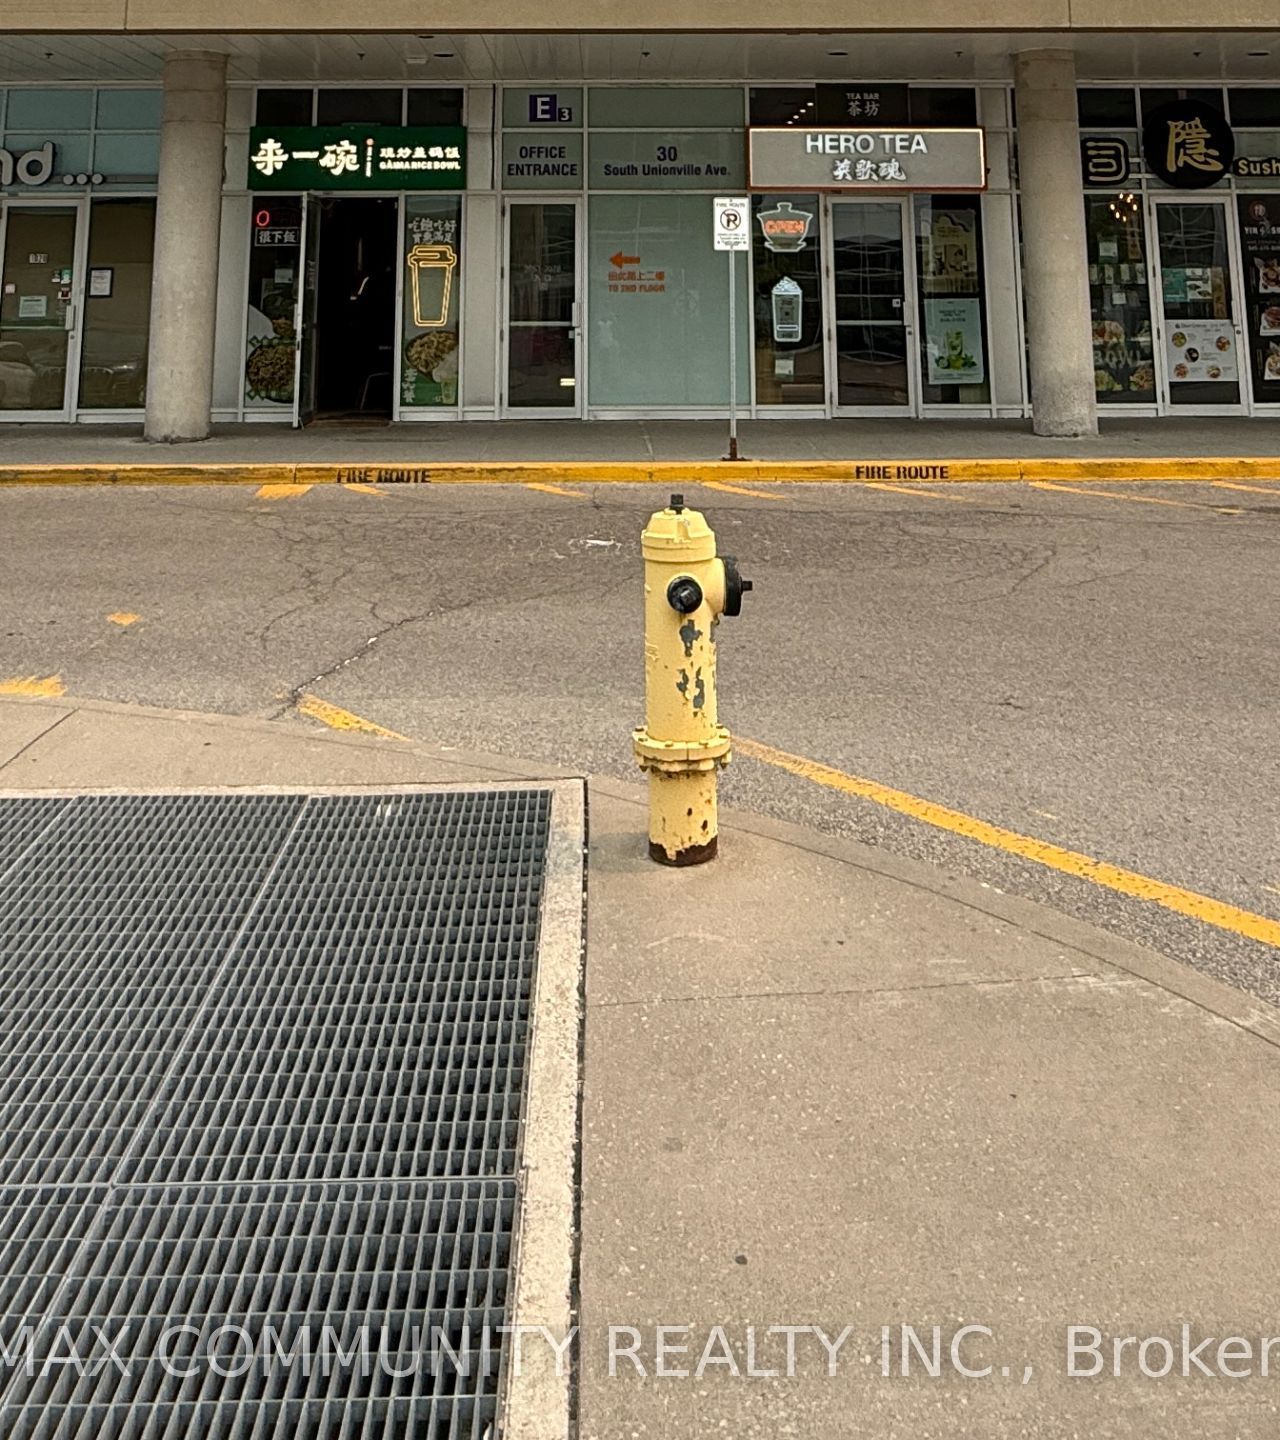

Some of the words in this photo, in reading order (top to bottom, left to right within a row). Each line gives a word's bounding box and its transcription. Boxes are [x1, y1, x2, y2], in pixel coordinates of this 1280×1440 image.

[805, 134, 875, 154] HERO
[878, 134, 928, 154] TEA
[520, 146, 566, 159] OFFICE
[656, 146, 678, 162] 30
[433, 161, 462, 170] BOWL
[507, 163, 578, 176] ENTRANCE
[604, 163, 638, 176] South
[642, 163, 702, 176] Unionville
[764, 219, 806, 234] OPEN
[376, 469, 432, 484] ROUTE
[855, 465, 892, 480] FIRE
[896, 465, 949, 480] ROUTE
